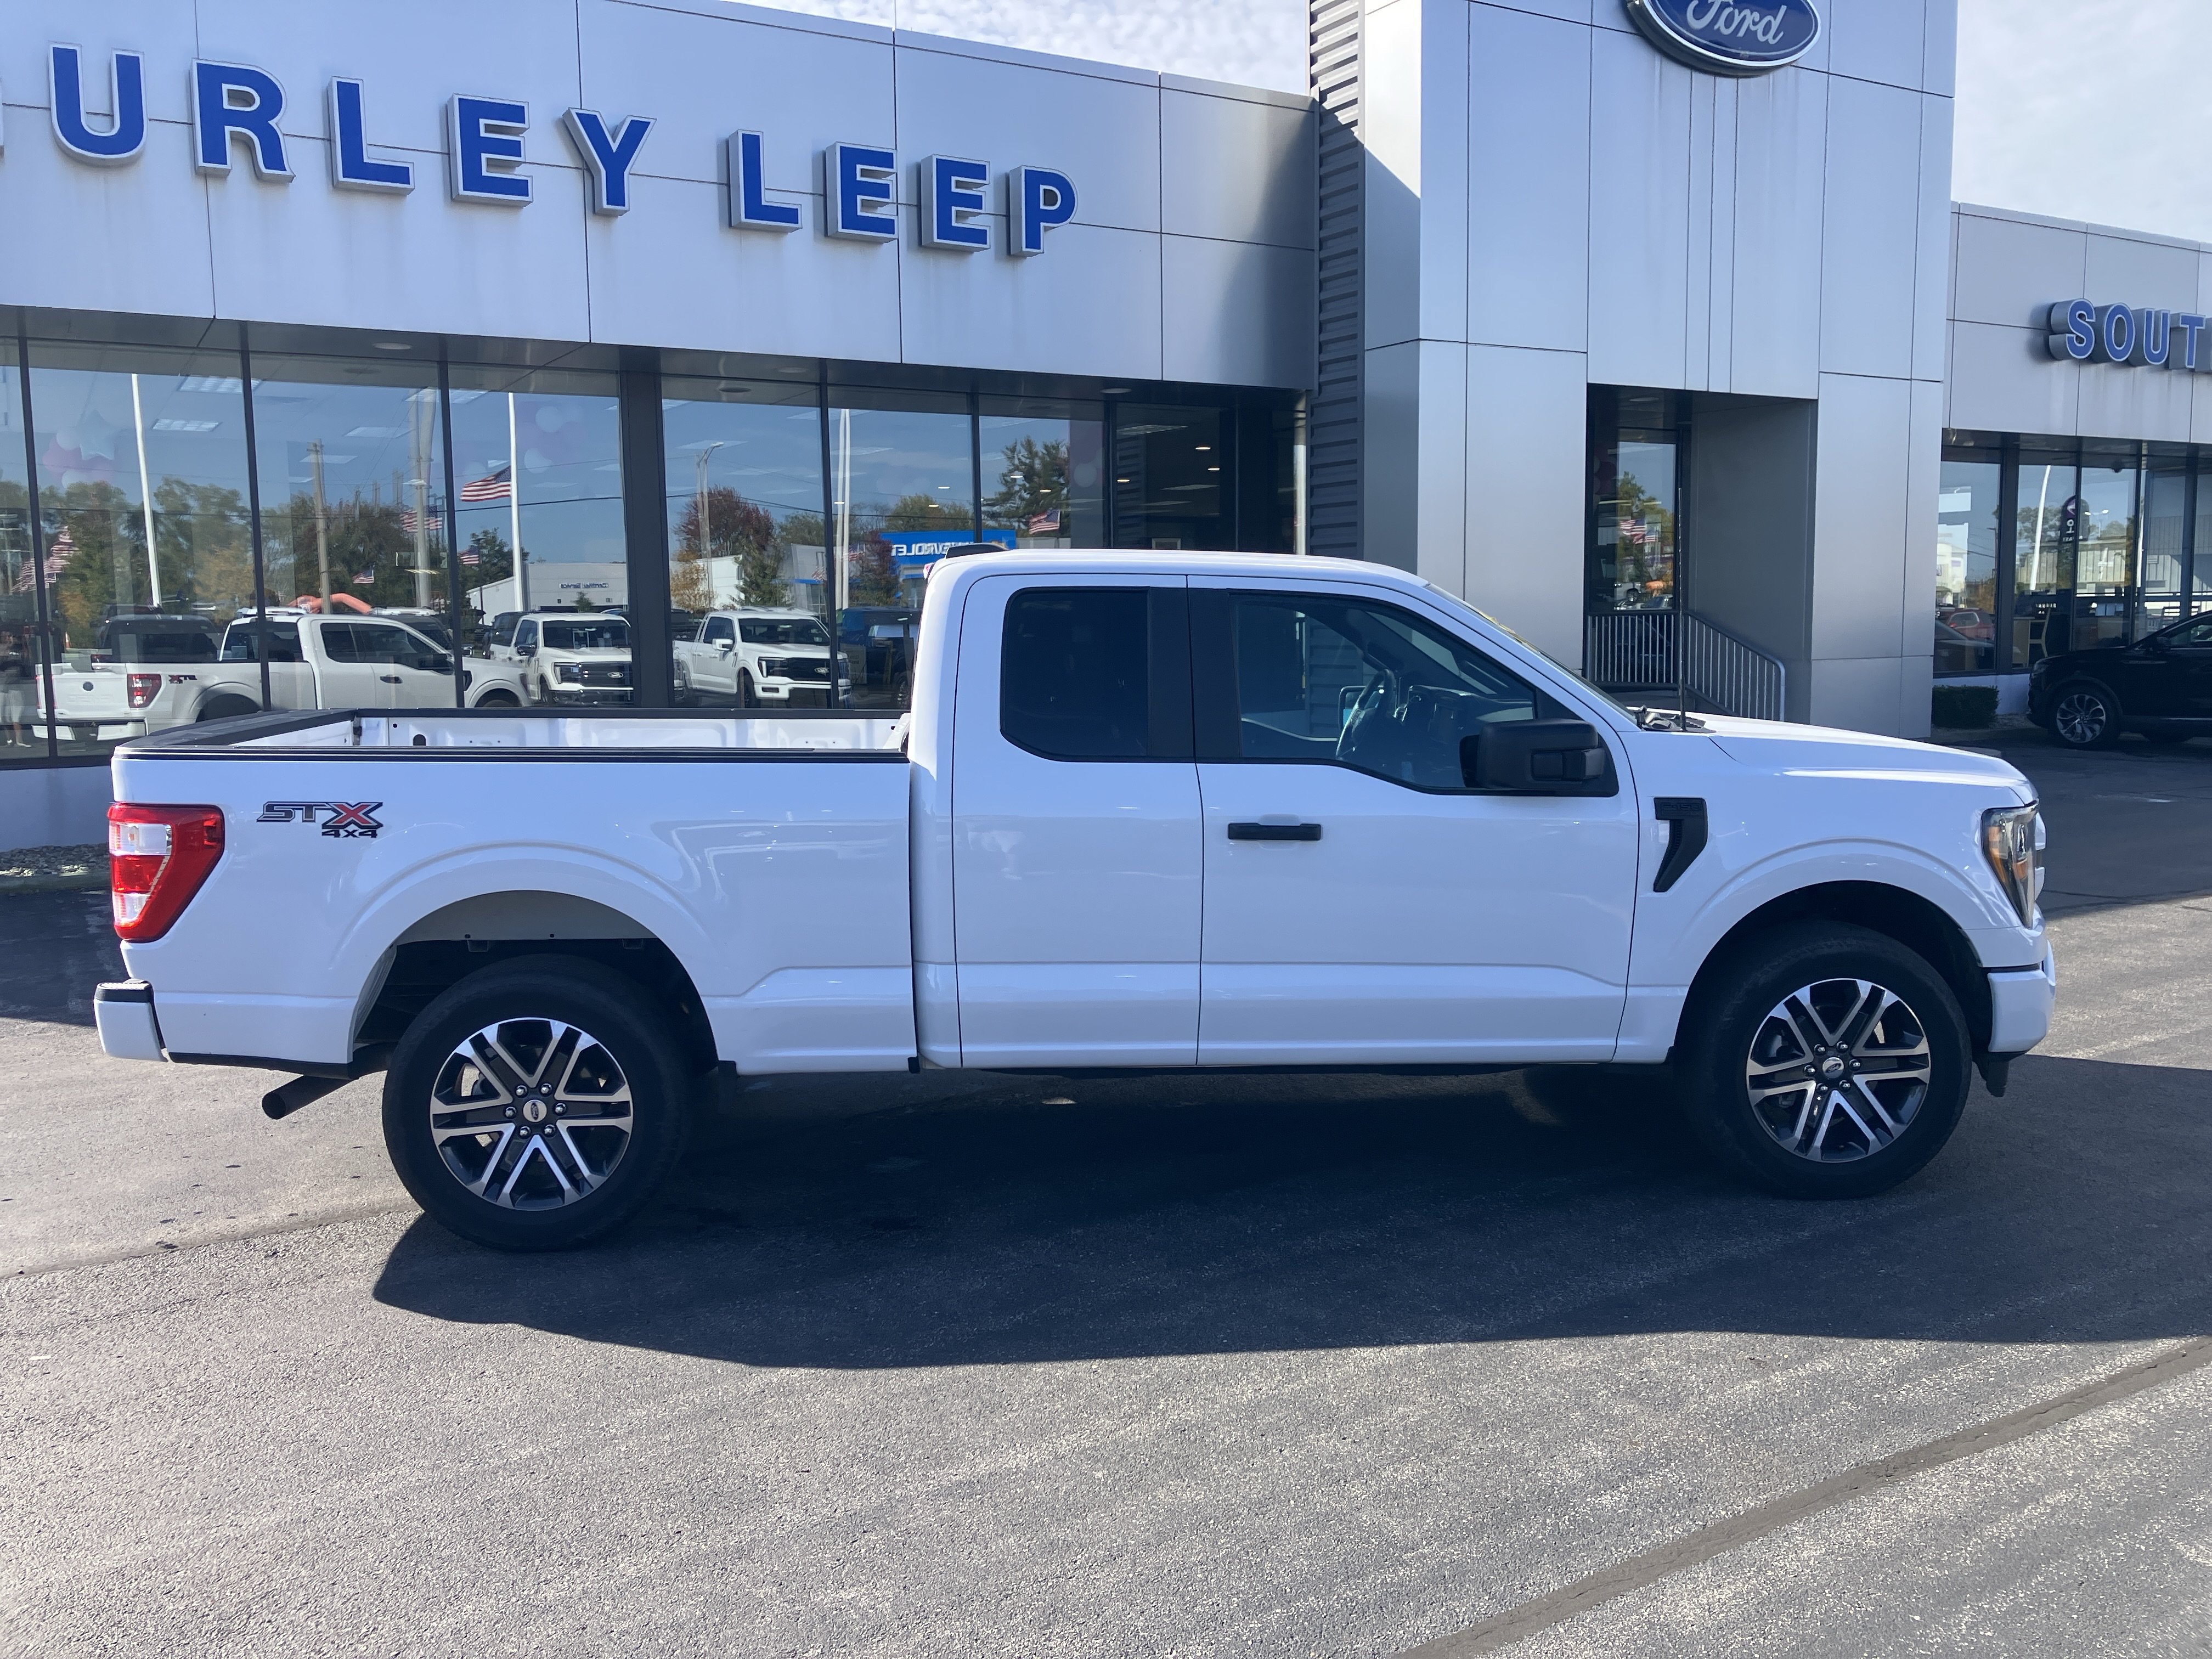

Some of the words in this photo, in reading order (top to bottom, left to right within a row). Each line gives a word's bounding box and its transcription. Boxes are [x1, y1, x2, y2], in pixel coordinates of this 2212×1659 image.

[1686, 0, 1784, 44] Ford
[0, 41, 657, 215] URLEY
[729, 129, 1077, 258] LEEP
[2065, 298, 2212, 371] SOUT
[256, 802, 383, 829] STX
